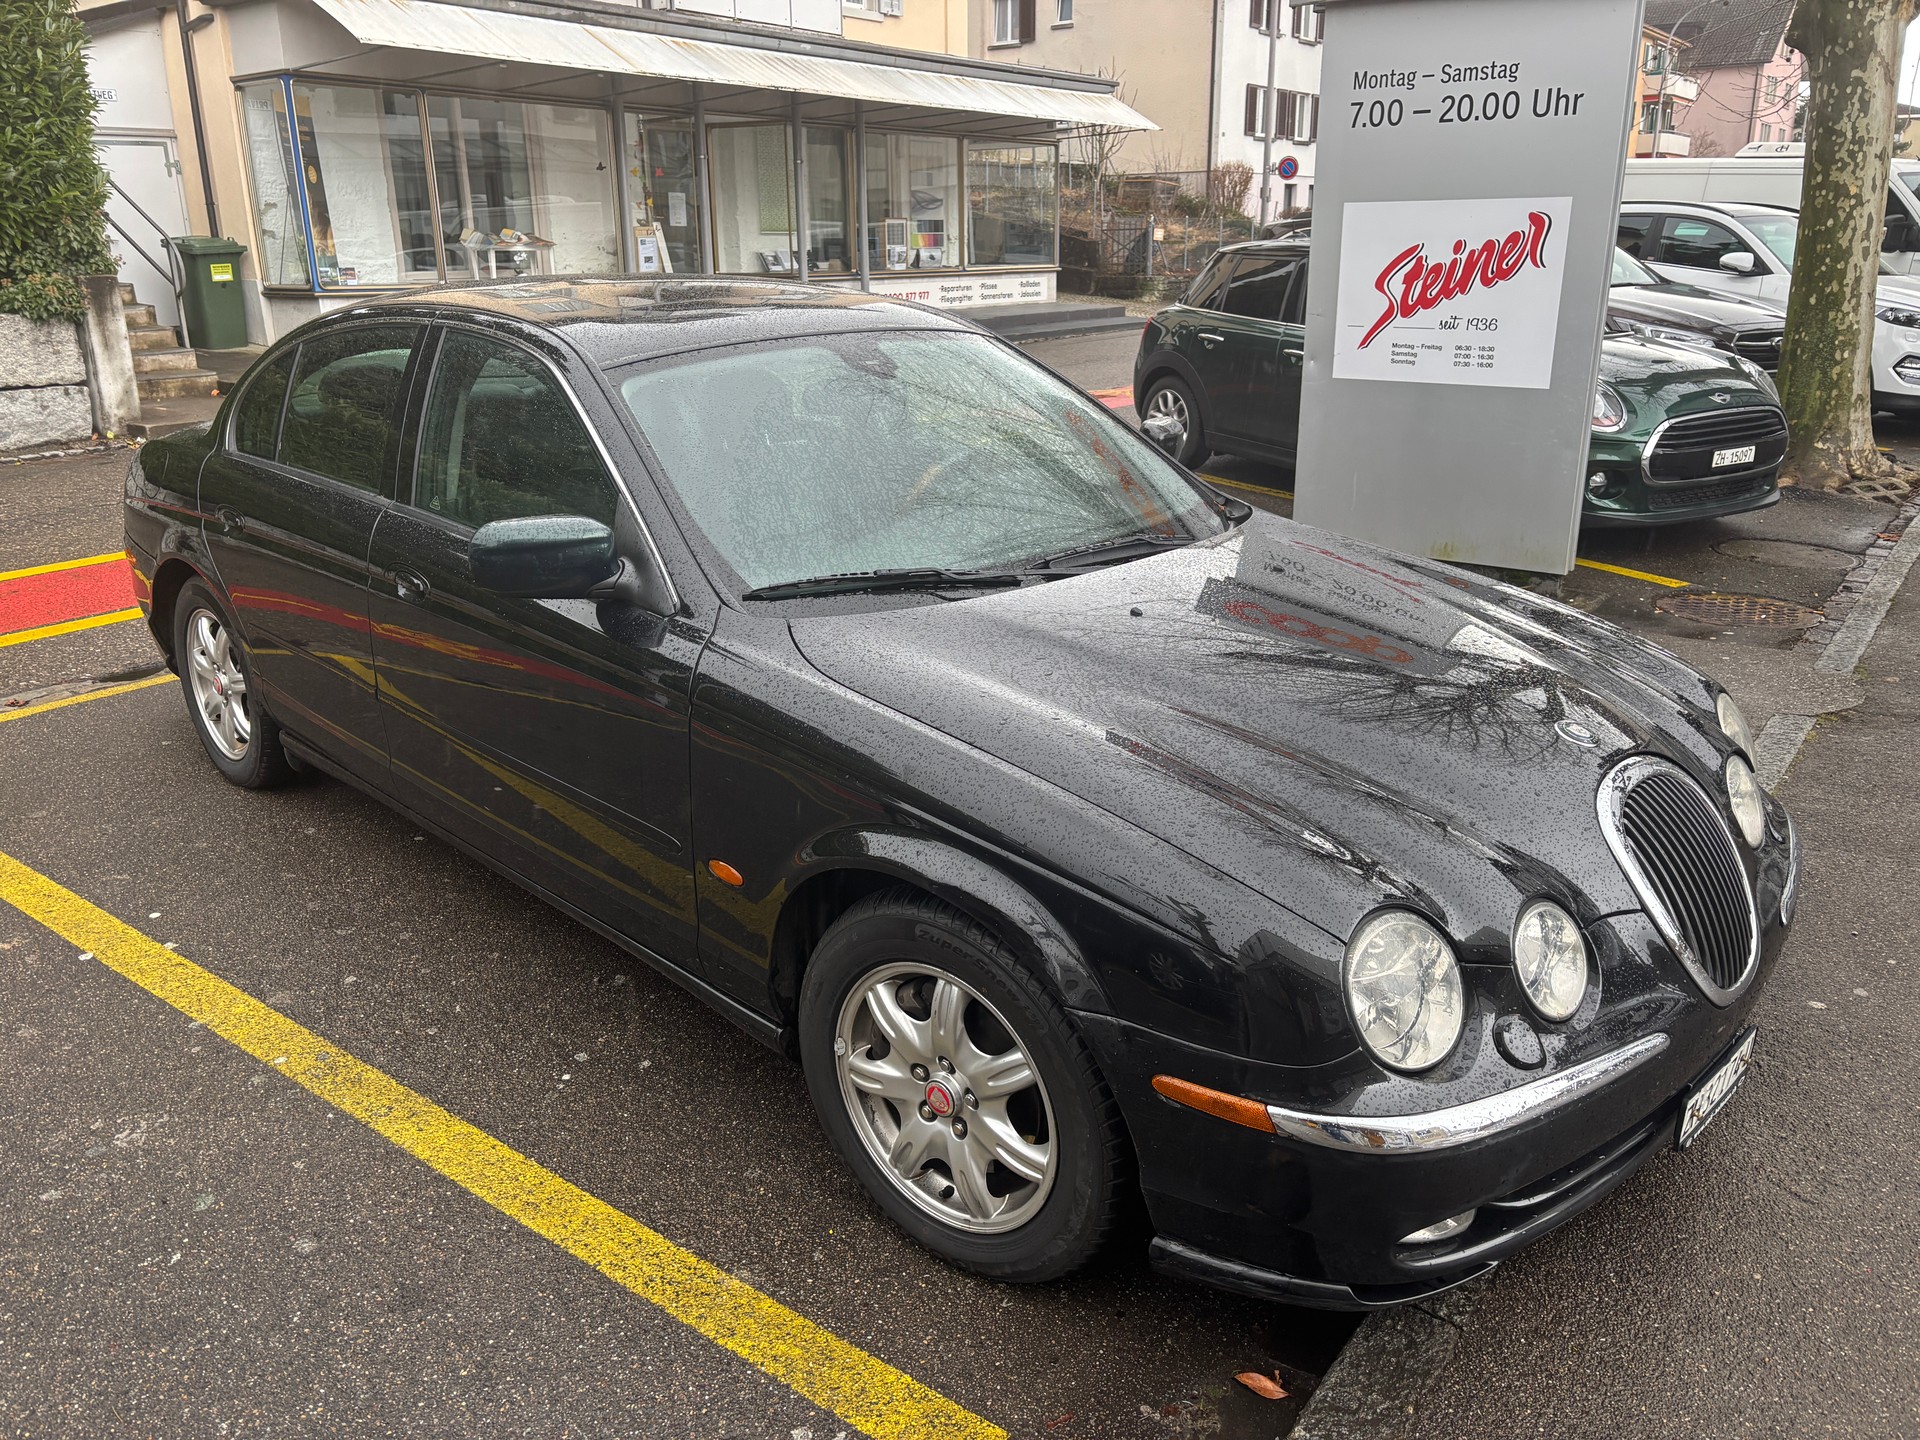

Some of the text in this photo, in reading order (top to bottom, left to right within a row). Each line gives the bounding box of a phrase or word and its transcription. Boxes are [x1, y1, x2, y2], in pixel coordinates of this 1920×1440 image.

[1353, 69, 1417, 90] Montag
[1440, 60, 1520, 83] Samstag
[1350, 98, 1404, 128] 7.00
[1438, 90, 1521, 123] 20.00
[1531, 87, 1585, 118] Uhr
[1357, 210, 1552, 350] Steiner
[918, 290, 930, 300] 977
[1439, 315, 1498, 331] seit 1936
[1391, 342, 1414, 351] Montag
[1420, 343, 1442, 352] Freitag
[1391, 350, 1418, 358] Samstag
[1390, 358, 1416, 366] Sonntag
